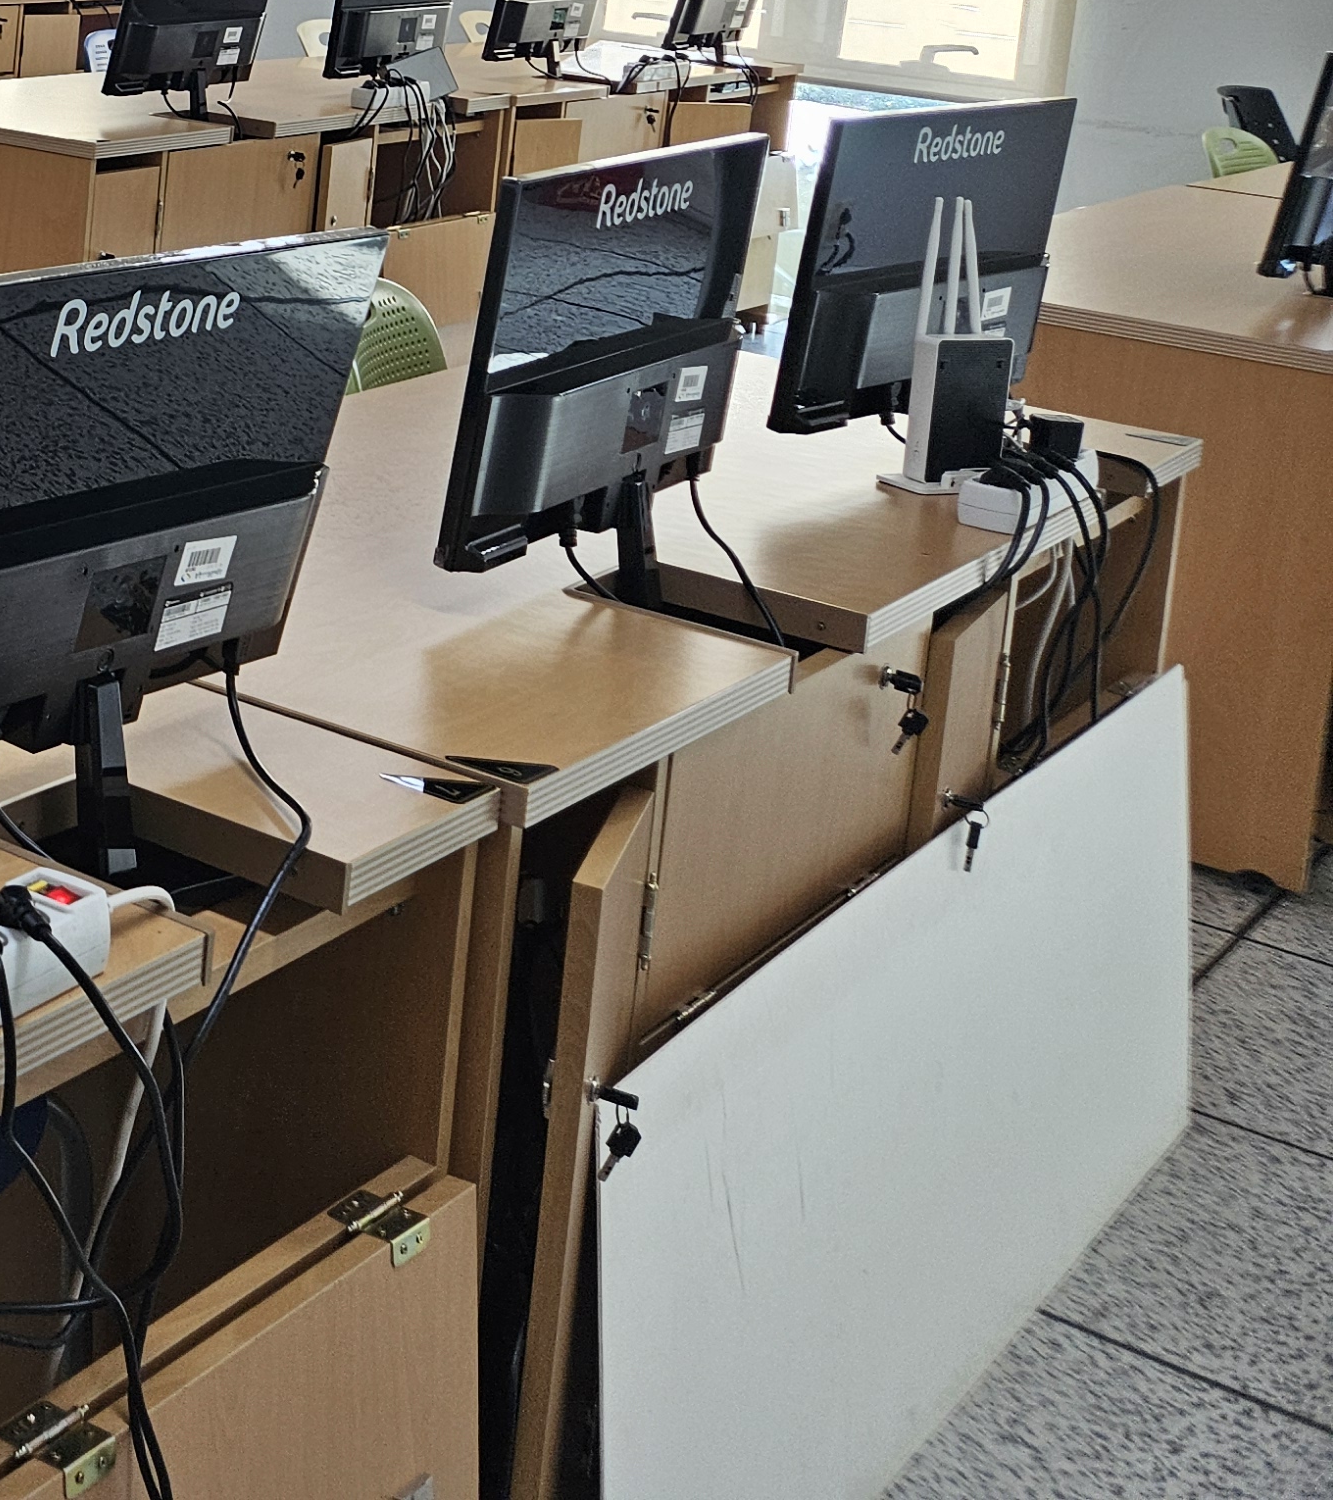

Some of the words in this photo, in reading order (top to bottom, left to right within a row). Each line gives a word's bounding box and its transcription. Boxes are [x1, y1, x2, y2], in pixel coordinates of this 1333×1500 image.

[914, 125, 1005, 164] Redstone
[596, 177, 694, 230] Redstone
[51, 289, 241, 358] Redstone
